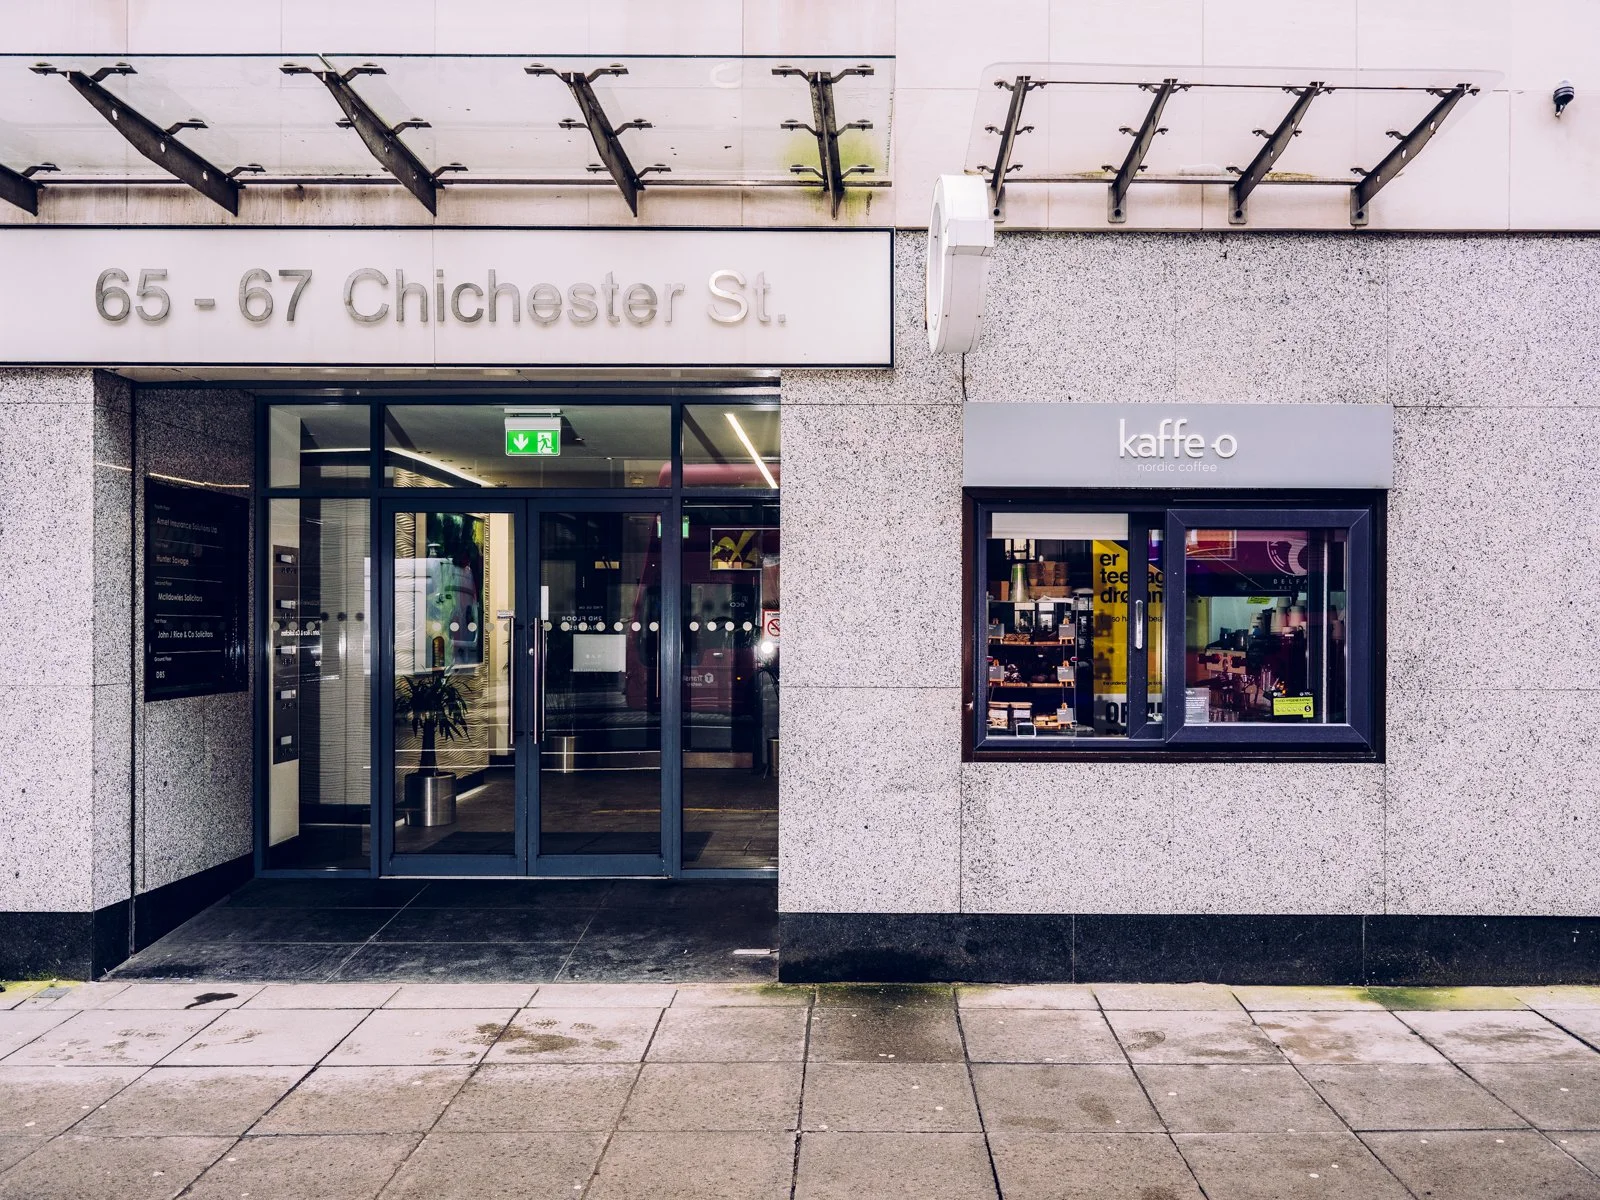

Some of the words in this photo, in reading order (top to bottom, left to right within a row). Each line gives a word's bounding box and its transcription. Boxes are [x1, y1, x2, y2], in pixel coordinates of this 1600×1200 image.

[95, 267, 171, 322] 65
[194, 298, 216, 307] -
[238, 267, 313, 322] 67
[343, 267, 686, 323] Chichester
[706, 268, 787, 323] St.
[1137, 460, 1175, 472] nordic
[1178, 460, 1218, 472] coffee
[1099, 553, 1120, 567] er
[158, 631, 169, 639] John
[173, 630, 183, 638] Rice
[195, 630, 214, 638] Solicitors
[155, 670, 166, 679] DBS
